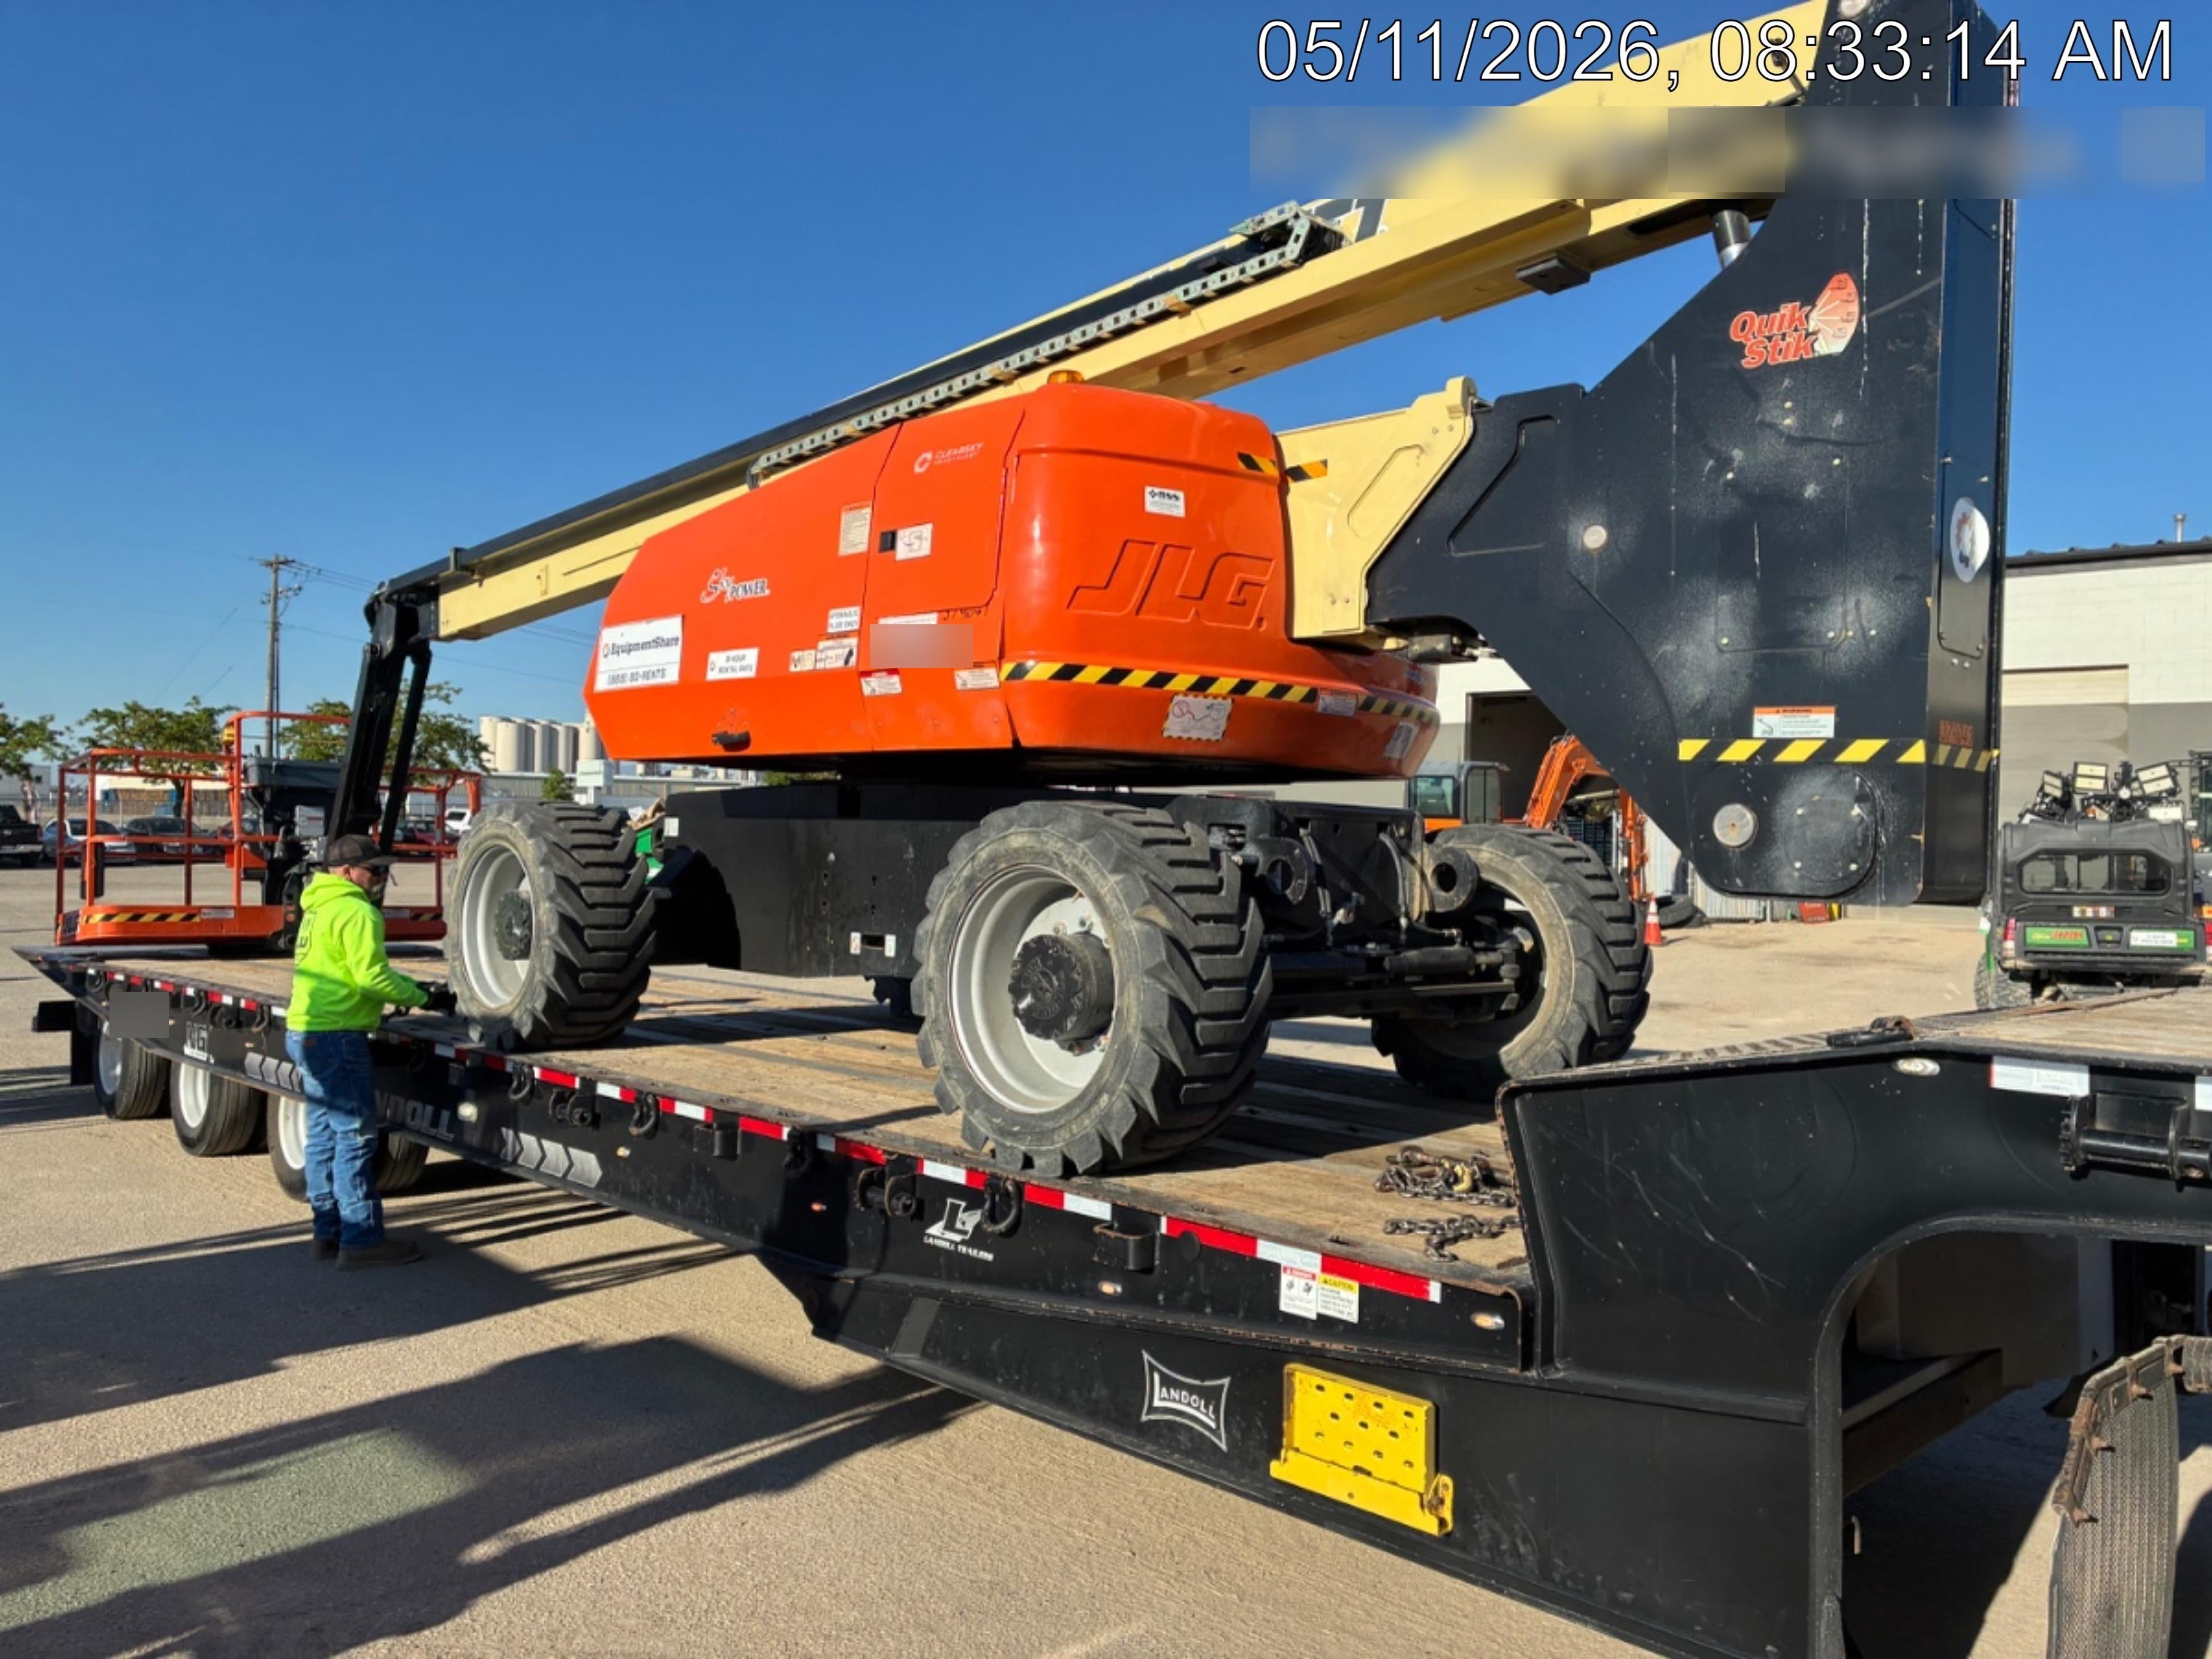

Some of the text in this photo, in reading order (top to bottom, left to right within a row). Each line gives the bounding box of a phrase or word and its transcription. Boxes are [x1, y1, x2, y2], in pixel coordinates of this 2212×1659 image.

[1730, 302, 1812, 342] Quik
[1741, 330, 1817, 368] Stik
[1067, 539, 1276, 630] JLG
[611, 635, 679, 657] EquipmentShare
[1153, 1370, 1217, 1430] LANDOLL
